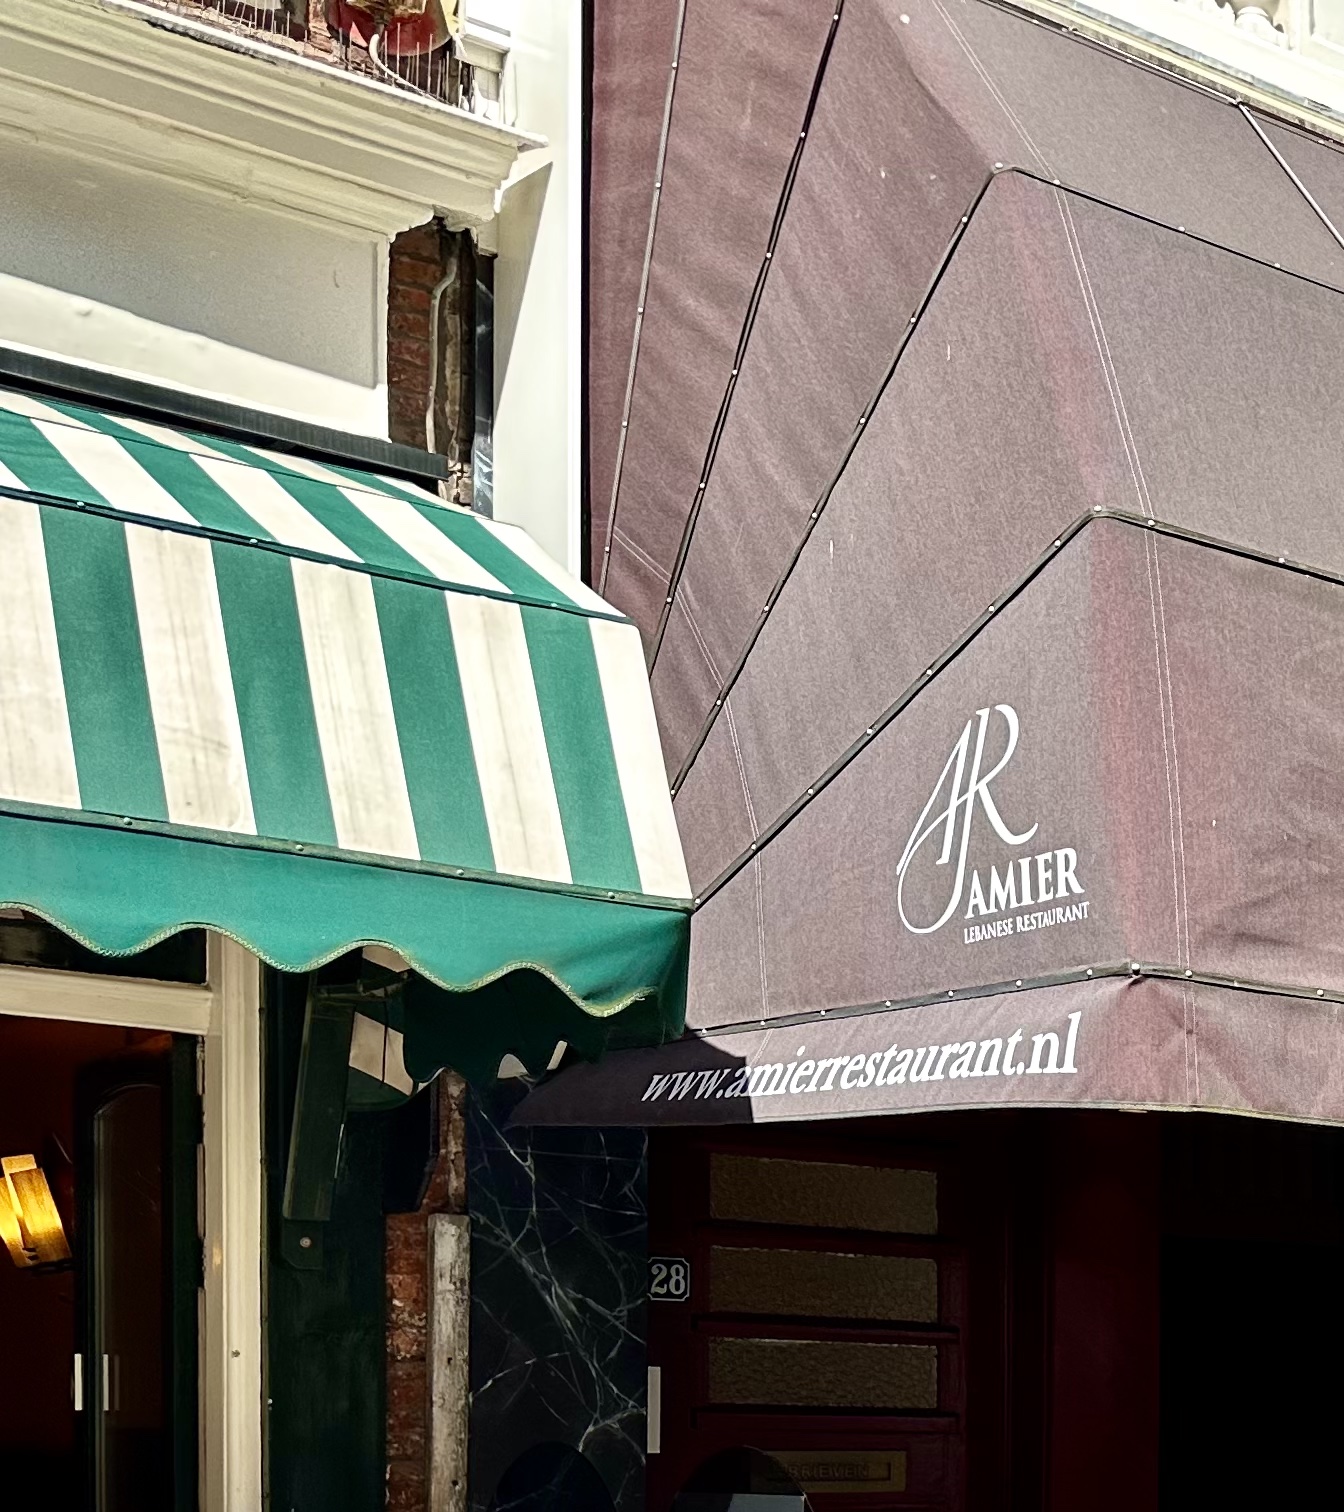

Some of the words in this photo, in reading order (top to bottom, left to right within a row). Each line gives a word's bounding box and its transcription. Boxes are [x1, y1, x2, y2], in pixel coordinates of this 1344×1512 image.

[964, 847, 1085, 920] AMIER
[964, 919, 1014, 945] LEBANESE
[1017, 902, 1090, 933] RESTAURANT
[641, 1011, 1082, 1102] www.amierrestaurant.nl
[649, 1262, 686, 1297] 28
[788, 1463, 870, 1478] BRIEVEN
